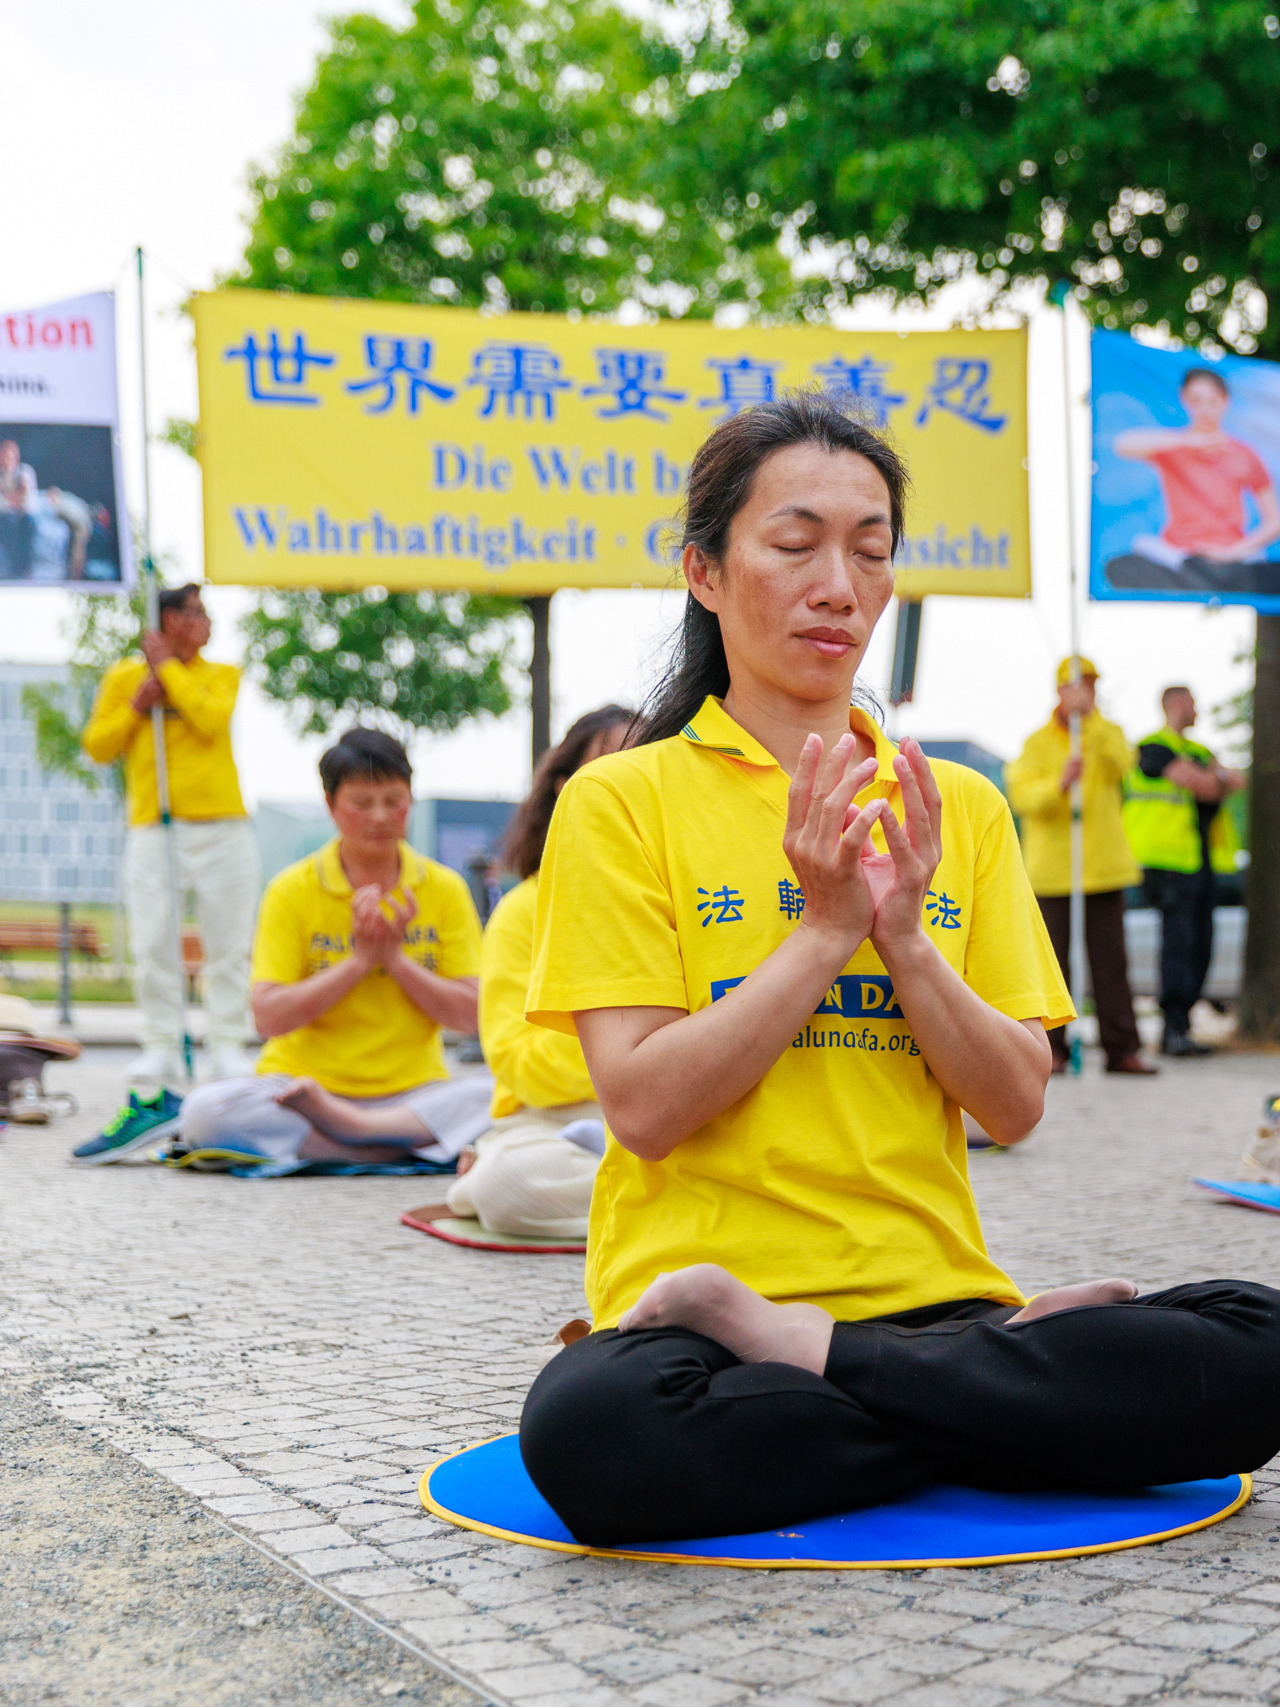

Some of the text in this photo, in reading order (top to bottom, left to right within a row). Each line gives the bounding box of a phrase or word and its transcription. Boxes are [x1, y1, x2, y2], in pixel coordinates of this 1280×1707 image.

[430, 443, 512, 493] Die
[526, 445, 637, 496] Welt
[230, 506, 598, 573] Wahrhaftigkeit
